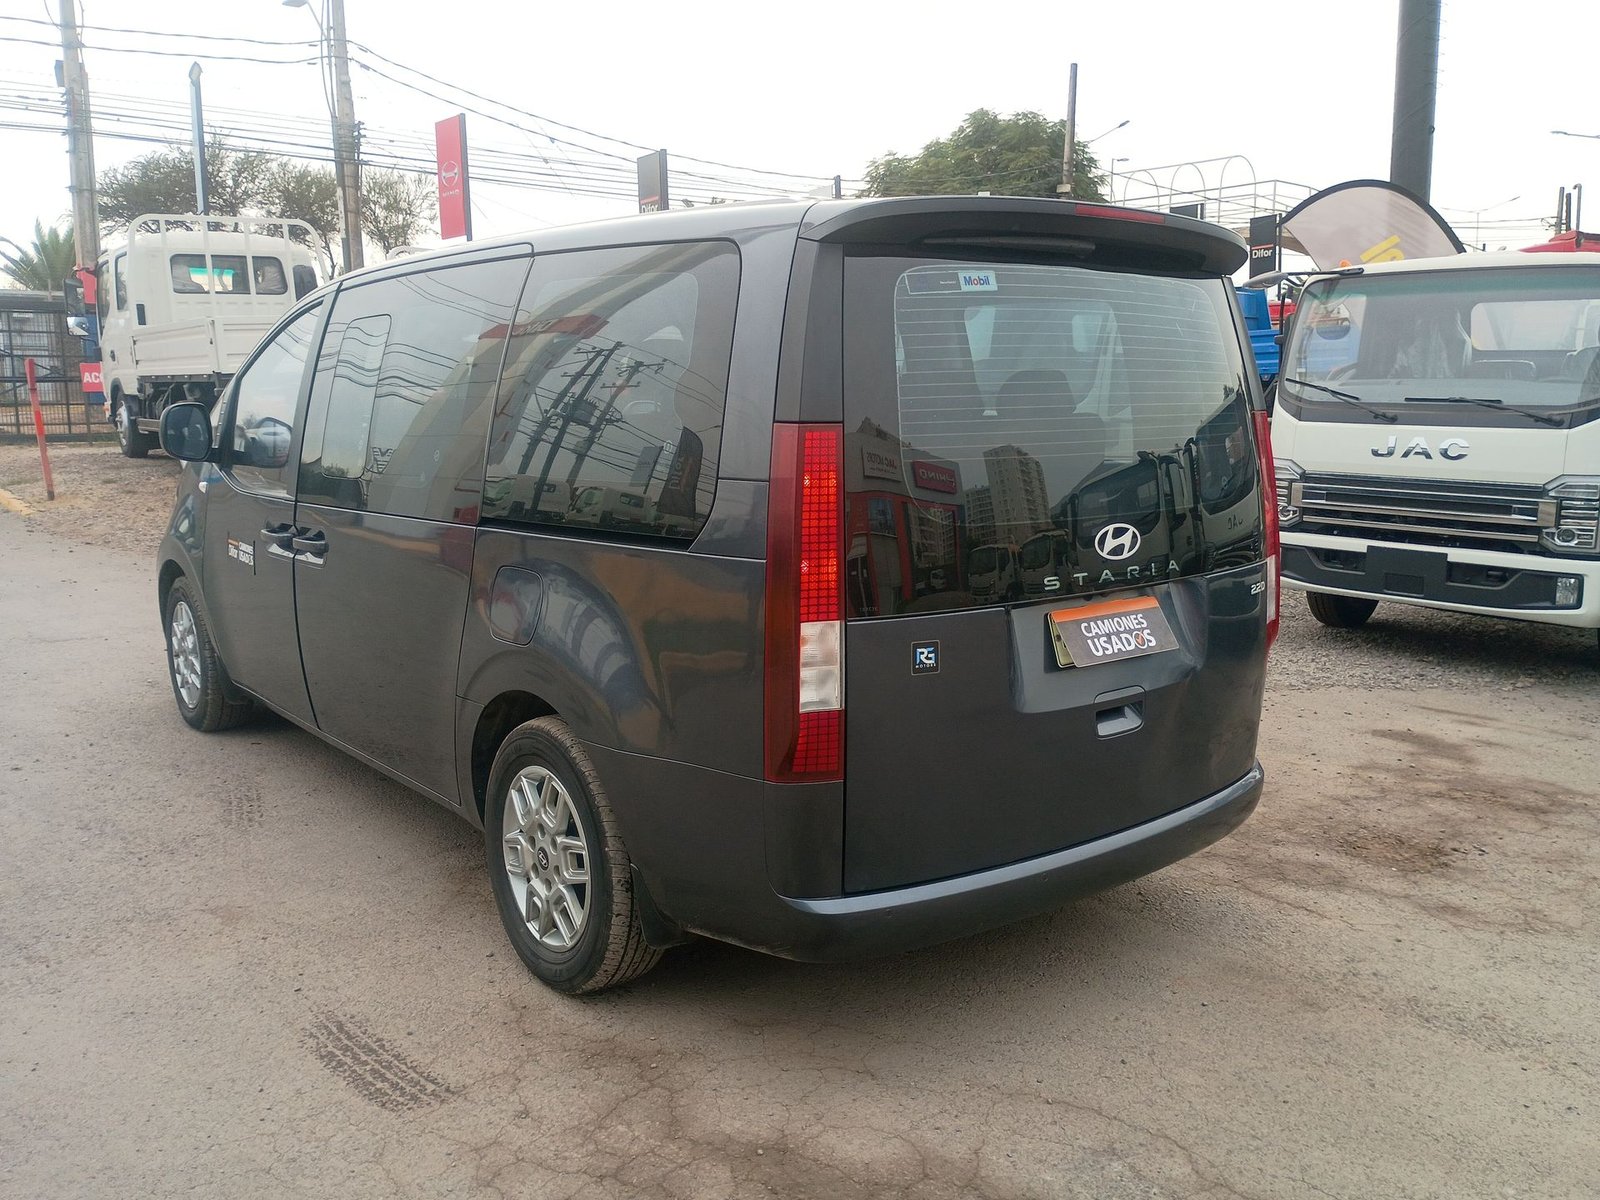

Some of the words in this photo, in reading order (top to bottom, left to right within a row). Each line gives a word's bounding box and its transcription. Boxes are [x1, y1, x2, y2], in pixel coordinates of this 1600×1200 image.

[1252, 247, 1273, 259] Difor
[963, 275, 991, 287] Mobil
[1370, 435, 1471, 461] JAC
[1043, 559, 1180, 592] STARIA
[1080, 613, 1148, 637] CAMIONES
[1087, 628, 1157, 657] USADOS
[916, 647, 935, 664] RG
